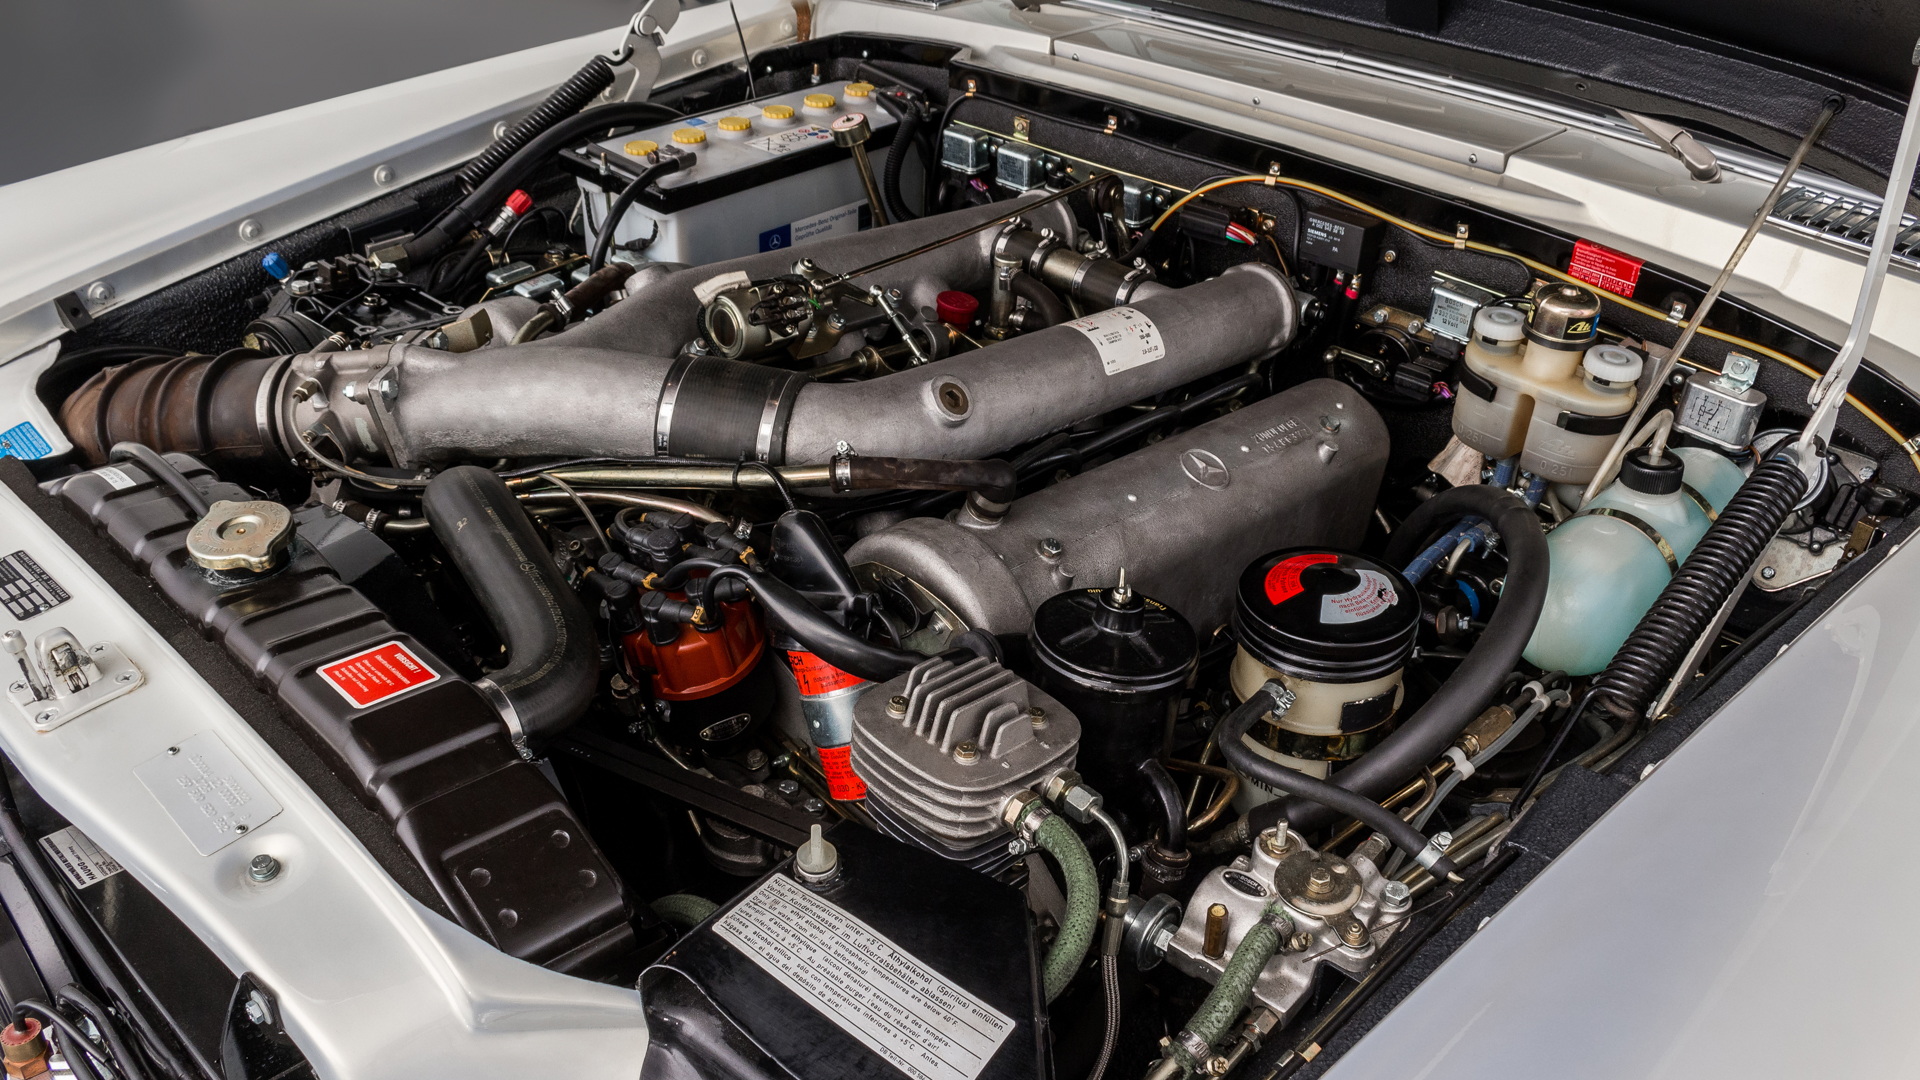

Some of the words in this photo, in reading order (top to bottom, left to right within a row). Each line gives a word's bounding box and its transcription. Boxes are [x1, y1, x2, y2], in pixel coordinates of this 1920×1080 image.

[1307, 228, 1327, 237] SIEMENS
[1445, 298, 1464, 308] BOSCH
[17, 551, 43, 574] DAIMLER-BENZ
[46, 579, 68, 598] STUTTGART
[394, 652, 414, 671] VORSICHT
[77, 861, 98, 881] HAUGG
[1240, 876, 1258, 886] BOSCH
[721, 919, 744, 936] hágase
[742, 933, 758, 946] salir
[764, 951, 780, 964] agua
[780, 962, 792, 972] del
[790, 970, 818, 992] depósito
[817, 989, 827, 998] de
[826, 996, 842, 1010] aire!
[743, 901, 766, 918] Remplir
[767, 916, 792, 934] d'alcool
[789, 932, 819, 954] éthylique
[821, 955, 843, 972] (alcool
[841, 969, 873, 993] dénaturé)
[871, 991, 904, 1016] seulement
[910, 1017, 923, 1029] des
[921, 1026, 952, 1050] tempéra-
[751, 895, 767, 906] Drain
[776, 910, 794, 923] water
[793, 921, 809, 933] from
[807, 932, 833, 950] air-tank
[832, 949, 869, 976] beforehand!
[757, 890, 772, 900] Only
[789, 908, 805, 920] ethyl
[803, 918, 826, 935] alcohol
[833, 939, 871, 967] atmospheric
[869, 965, 911, 995] temperatures
[909, 993, 922, 1003] are
[922, 1001, 942, 1016] below
[765, 883, 788, 899] Vorher
[788, 896, 840, 932] Kondenswasser
[840, 930, 852, 940] im
[850, 938, 921, 987] Luftvorratsbehälter
[919, 984, 956, 1011] ablassen!
[772, 878, 785, 888] Nur
[786, 887, 798, 896] bei
[798, 893, 844, 924] Temperaturen
[844, 922, 865, 937] unter
[935, 984, 971, 1010] (Spiritus)
[970, 1006, 1006, 1033] einfüllen.
[729, 913, 750, 929] Echese
[751, 929, 775, 947] alcohol
[809, 972, 822, 983] con
[821, 981, 863, 1013] temperaturas
[861, 1009, 892, 1034] inferiores
[920, 1051, 941, 1069] Antes.
[737, 906, 753, 918] tures
[752, 916, 781, 938] inférieurs
[806, 954, 817, 964] Au
[815, 962, 845, 985] préalable
[843, 983, 866, 1001] purger
[866, 998, 883, 1012] l'eau
[882, 1010, 893, 1019] du
[892, 1016, 921, 1039] réservoir
[921, 1036, 940, 1052] d'air!
